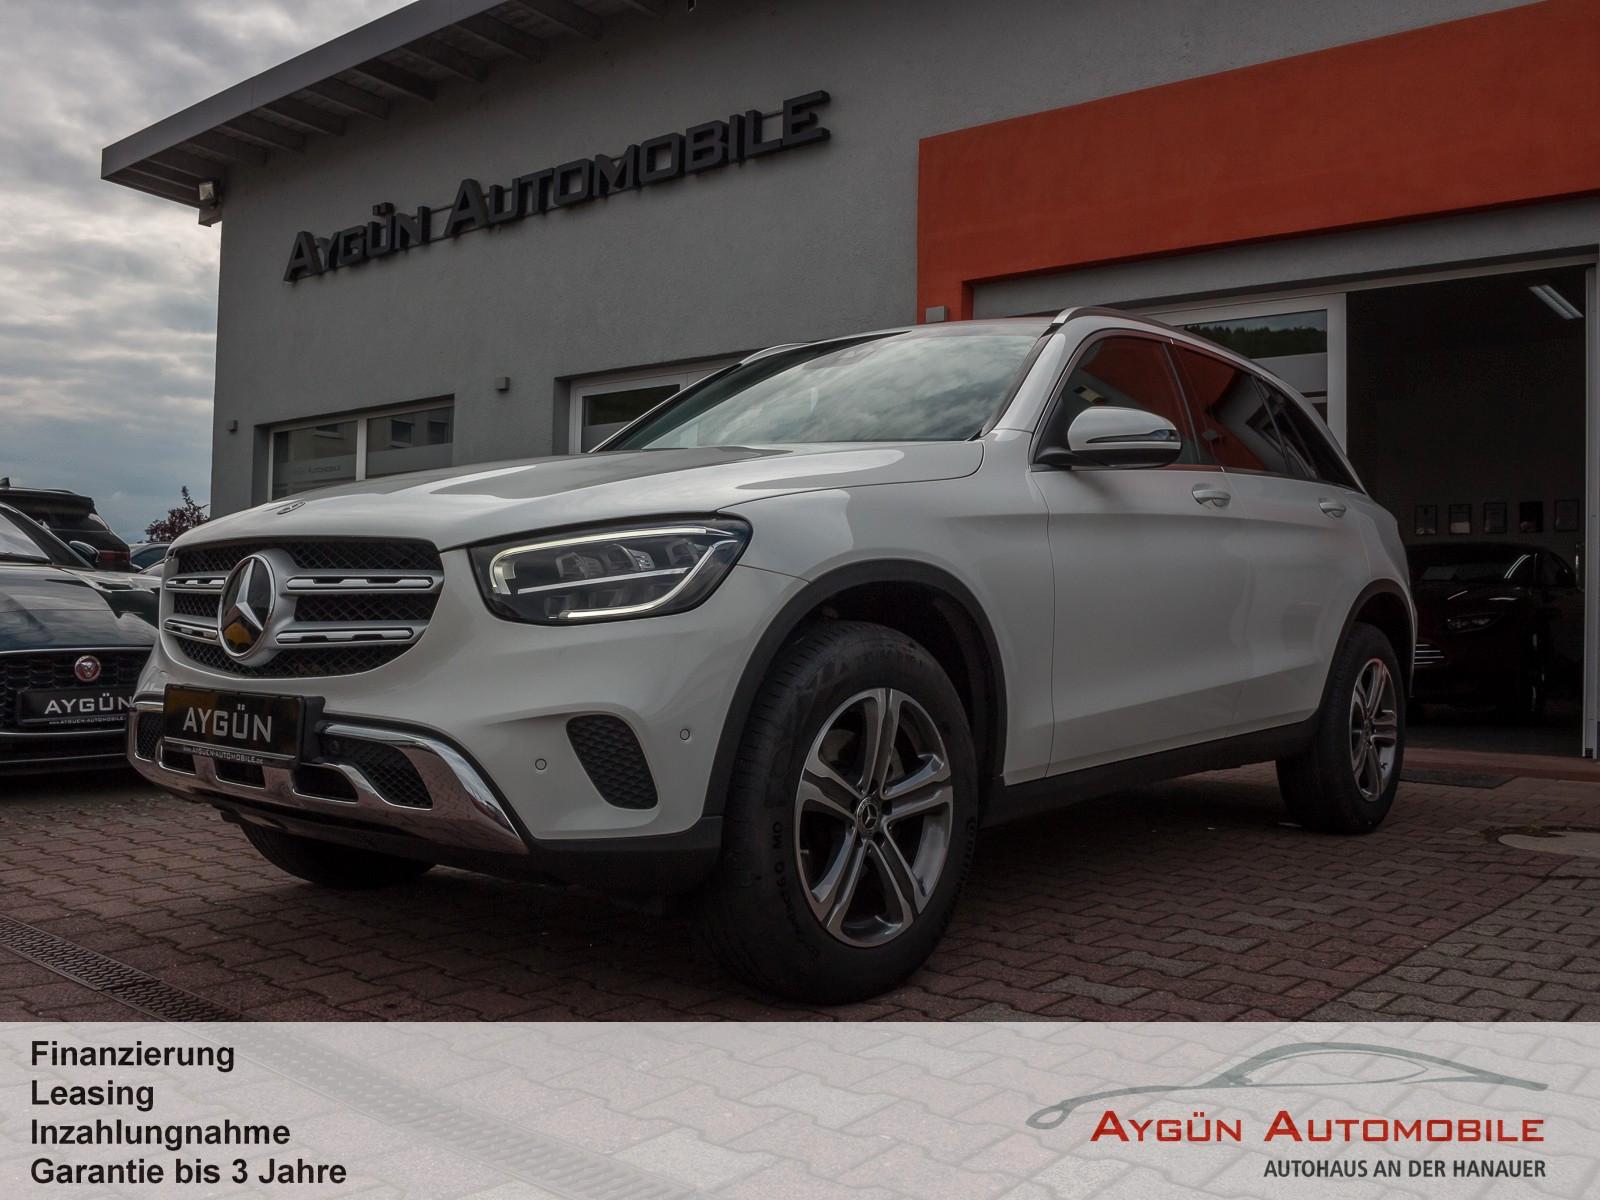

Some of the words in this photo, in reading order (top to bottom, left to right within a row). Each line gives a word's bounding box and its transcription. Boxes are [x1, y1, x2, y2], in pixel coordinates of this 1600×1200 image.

[284, 202, 431, 282] AYGÜN
[444, 90, 831, 237] AUTOMOBILE
[44, 692, 133, 714] AYGÜN
[183, 704, 272, 743] AYGÜN
